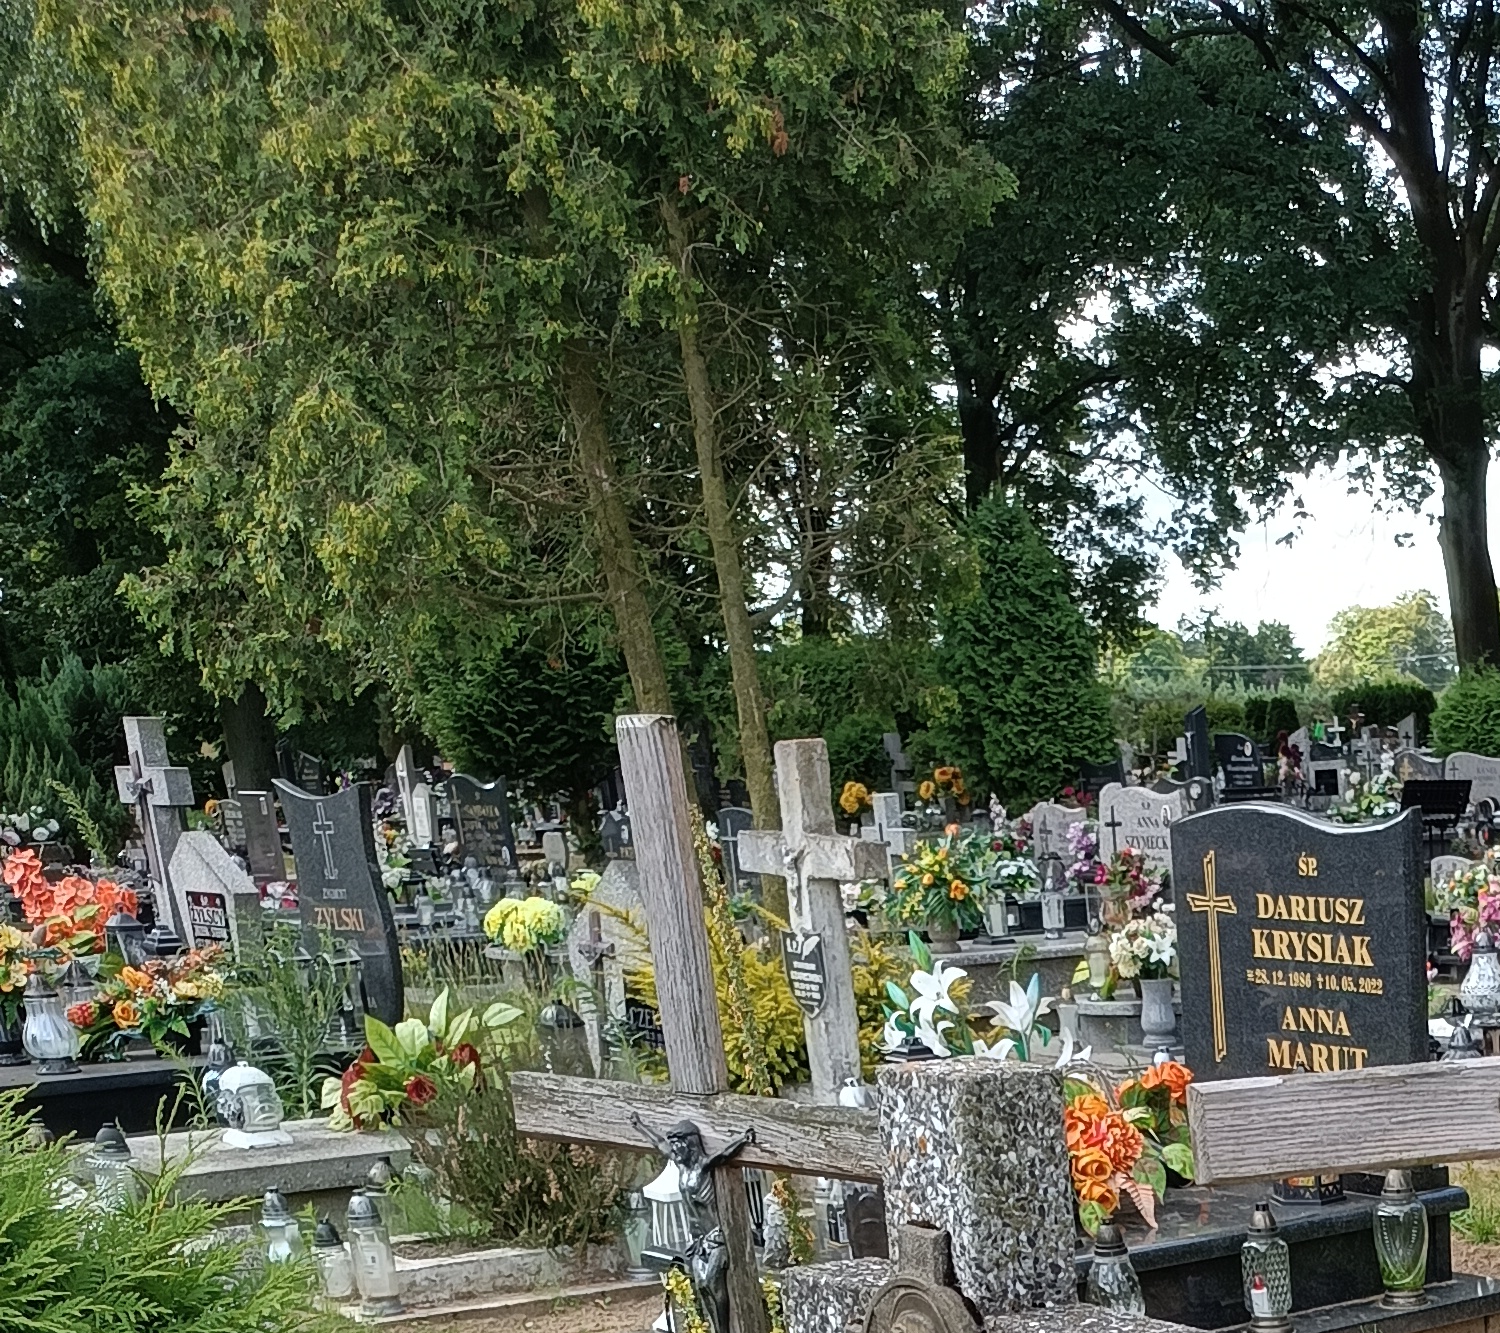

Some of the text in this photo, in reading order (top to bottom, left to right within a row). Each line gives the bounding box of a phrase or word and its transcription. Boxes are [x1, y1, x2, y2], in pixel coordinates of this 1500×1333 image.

[1256, 893, 1366, 925] DARIUSZ
[1251, 928, 1374, 967] KRYSIAK
[1282, 1005, 1351, 1036] ANNA
[1267, 1038, 1368, 1073] MARUT
